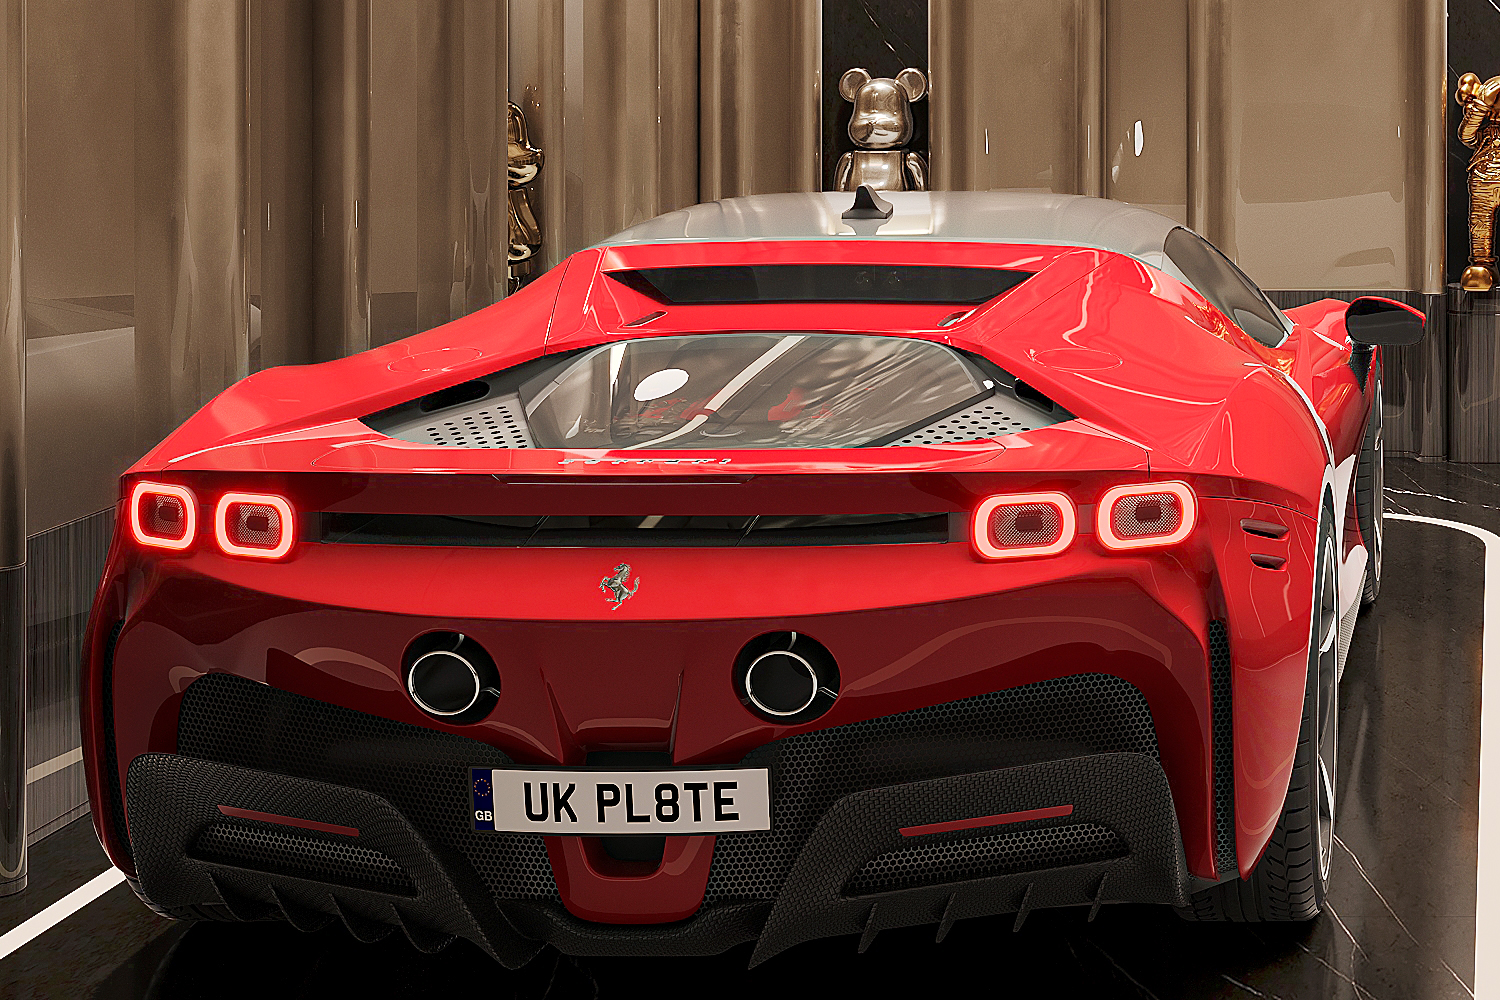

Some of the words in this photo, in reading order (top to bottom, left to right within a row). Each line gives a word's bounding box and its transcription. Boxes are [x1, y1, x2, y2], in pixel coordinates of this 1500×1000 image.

[523, 781, 578, 823] UK
[595, 781, 740, 823] PL8TE
[475, 810, 493, 822] GB
